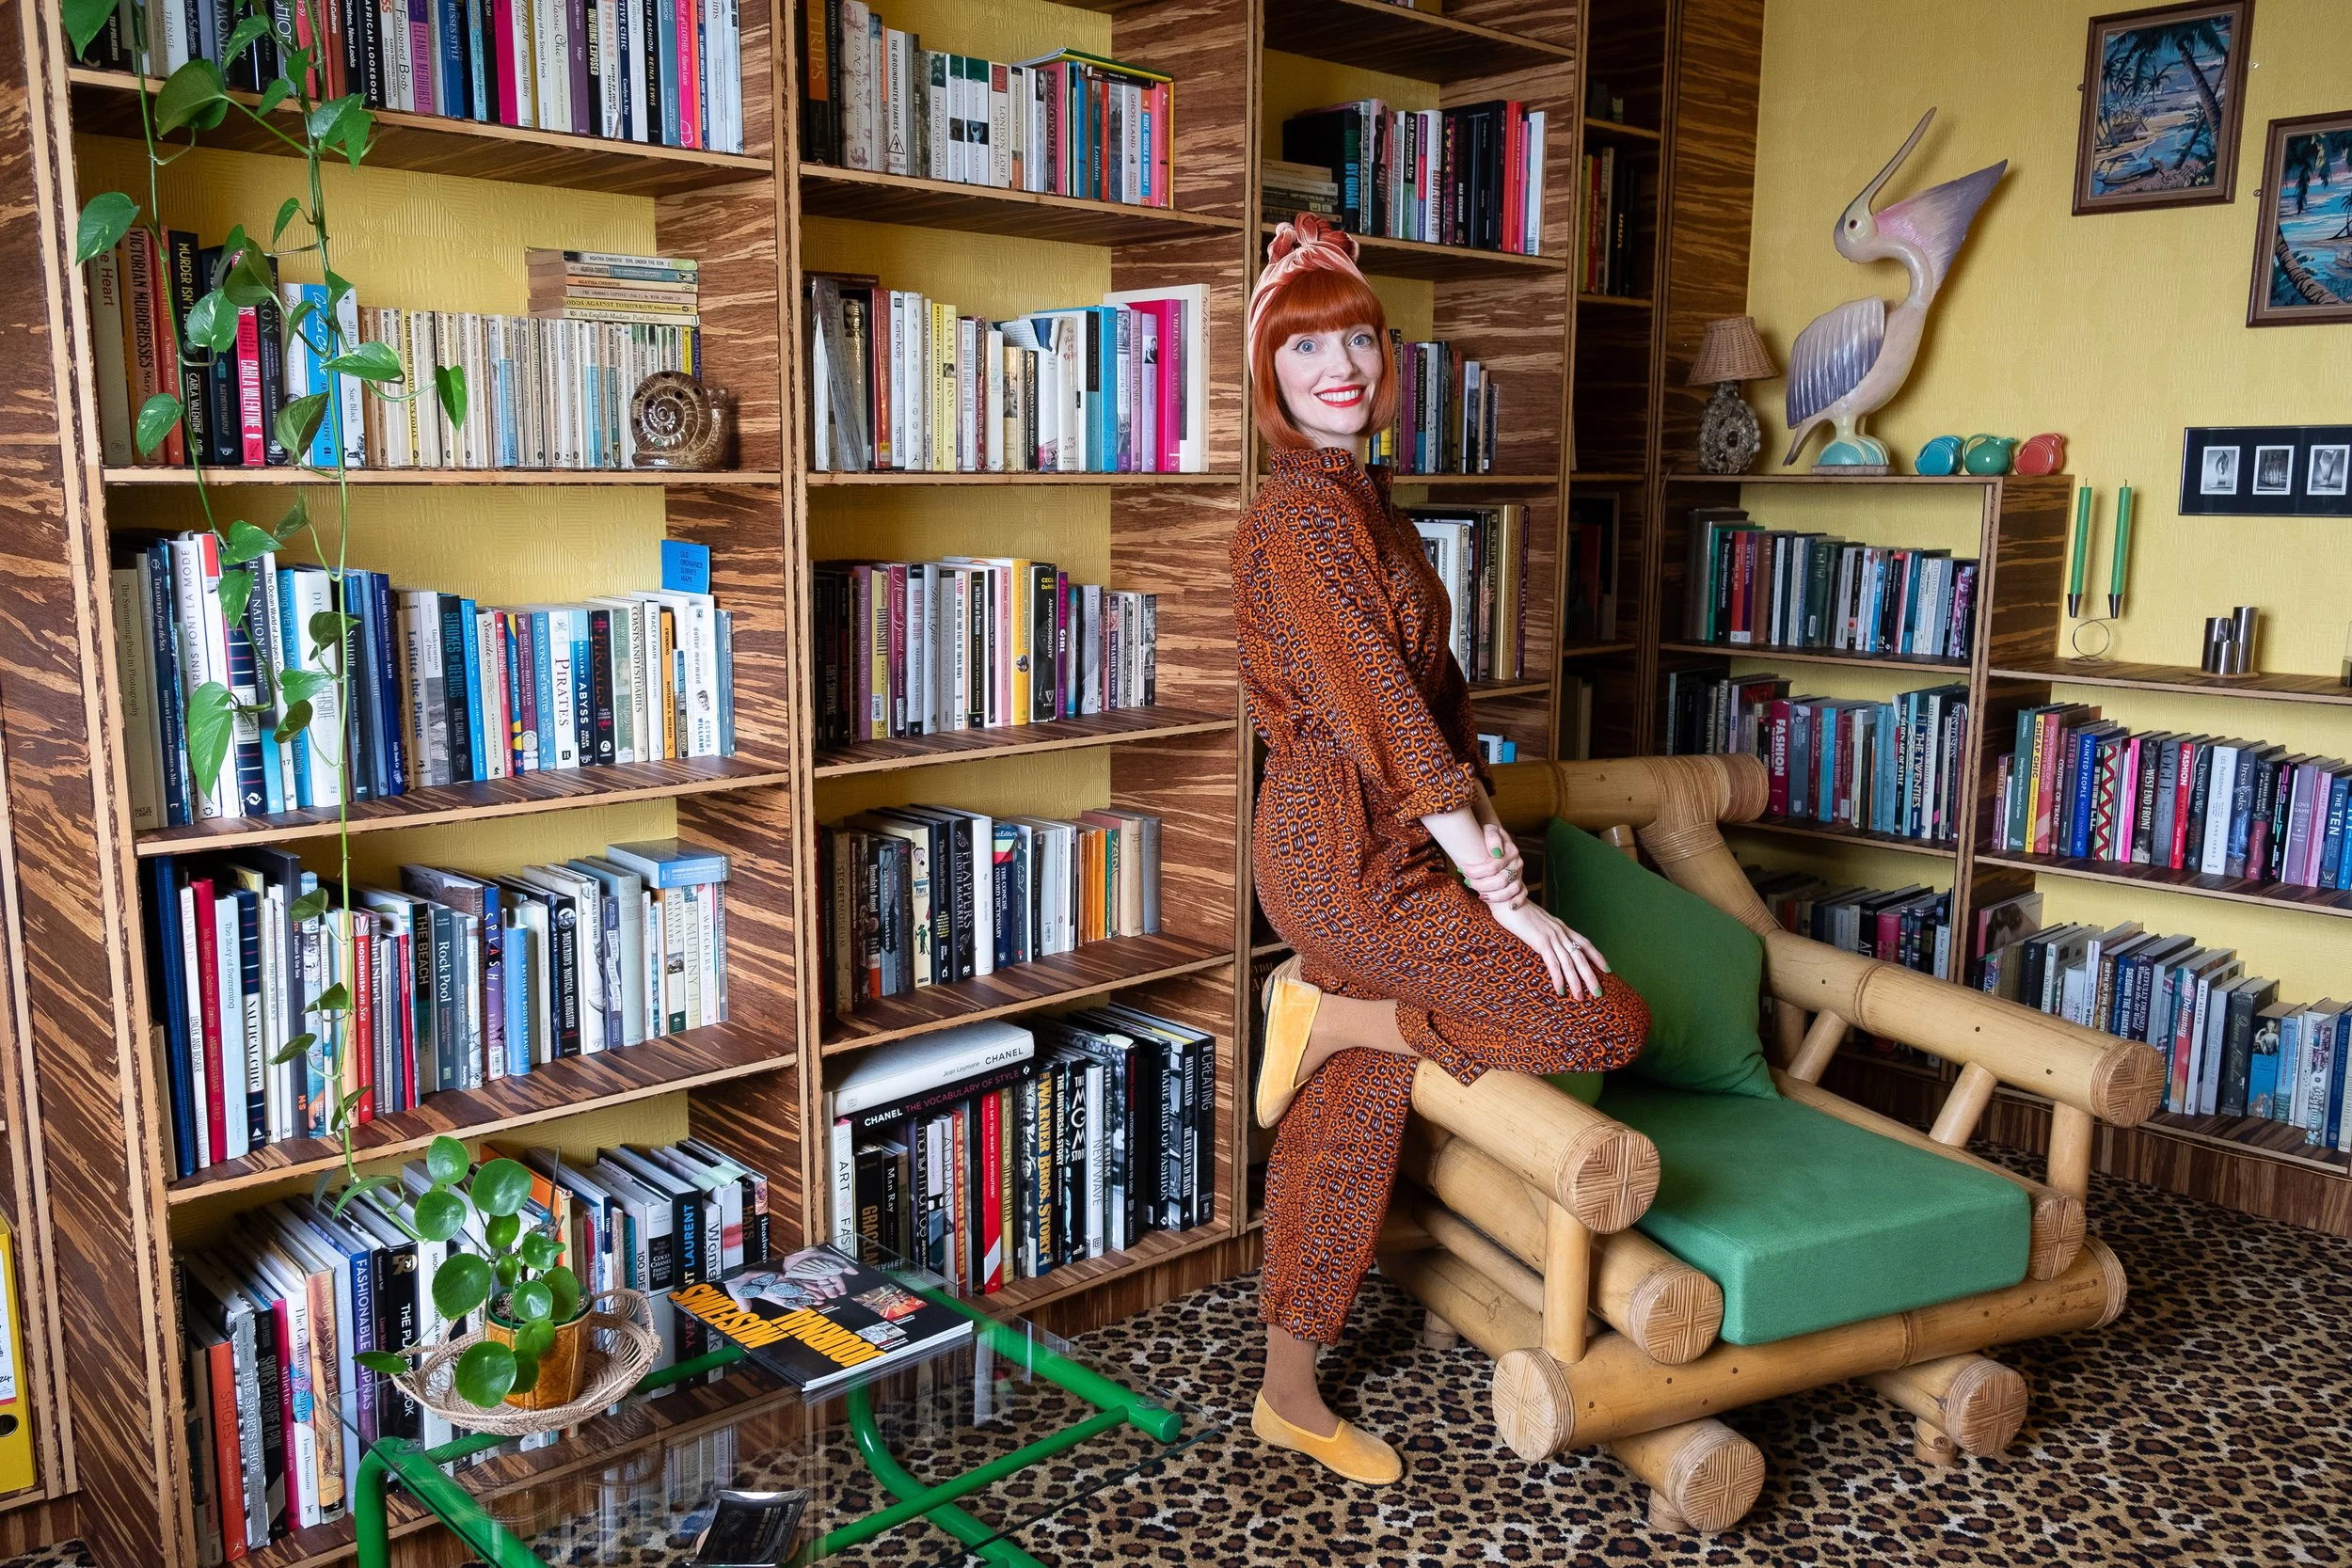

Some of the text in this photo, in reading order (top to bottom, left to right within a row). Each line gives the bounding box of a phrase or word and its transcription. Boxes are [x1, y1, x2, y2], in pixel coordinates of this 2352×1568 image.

[365, 0, 377, 102] AFRICAN LOOKBOOK
[395, 9, 409, 91] Fashioned Body
[413, 24, 430, 106] ELEANOR MEDHURST
[588, 8, 599, 75] UNIFORMS EXPOSED
[1345, 163, 1359, 210] BY QUANT
[101, 268, 115, 306] Heart
[179, 244, 193, 284] MURDER
[130, 230, 153, 369] VICTORIAN MURDERESSES
[241, 360, 262, 428] CARLA VALENTINE
[121, 583, 130, 596] The
[181, 550, 192, 587] MODE
[122, 599, 134, 640] Swimming
[252, 599, 265, 646] NATION
[126, 641, 135, 657] Pool
[444, 613, 463, 698] STROKES GENIUS
[498, 639, 506, 673] SURFING
[631, 607, 643, 712] COASTS AND ESTUARIES
[128, 669, 138, 717] Photography
[407, 631, 424, 738] Lafitte the Pirate
[860, 667, 868, 689] Story
[579, 683, 588, 723] ABYSS
[1774, 720, 1786, 776] FASHION
[1913, 733, 1925, 807] THE TWENTIES
[2158, 748, 2175, 795] VOGUE
[2180, 751, 2189, 785] FASHION
[2080, 772, 2089, 798] PEOPLE
[2140, 769, 2154, 830] WEST END FRONT
[2194, 764, 2206, 813] Dressed War
[2237, 764, 2249, 811] Dress Codes
[2334, 794, 2343, 807] THE
[2329, 811, 2342, 835] TEN
[963, 851, 973, 928] FLAPPERS
[225, 922, 233, 940] The
[225, 942, 234, 958] Story
[226, 967, 236, 1008] Swimming
[370, 935, 382, 1005] Shell Shock
[438, 942, 452, 1003] Rock Pool
[2123, 968, 2134, 996] SHEDDING
[359, 994, 366, 1006] on
[359, 1007, 368, 1022] Sea
[2138, 966, 2151, 1031] ARTFULLY DRESSED
[2179, 972, 2195, 1038] Sonia Delaunay
[246, 1001, 261, 1087] NAUTICAL CHIC
[985, 1048, 1023, 1065] CHANEL
[865, 1070, 1020, 1127] CHANEL VOCABULARY STYLE
[1201, 1054, 1213, 1110] CREATING
[1162, 1134, 1169, 1149] OF
[886, 1167, 896, 1212] Man Ray
[1038, 1082, 1052, 1254] WARNER BROS. STORY
[1161, 1152, 1169, 1200] FASHION
[684, 1205, 694, 1267] LAURENT
[743, 1206, 754, 1240] HATS
[357, 1259, 371, 1349] FASHIONABLE
[769, 1309, 889, 1367] JOURNAL
[295, 1306, 311, 1425] The Gentleman's Slipper
[244, 1370, 260, 1473] THE SPORTS SHOE
